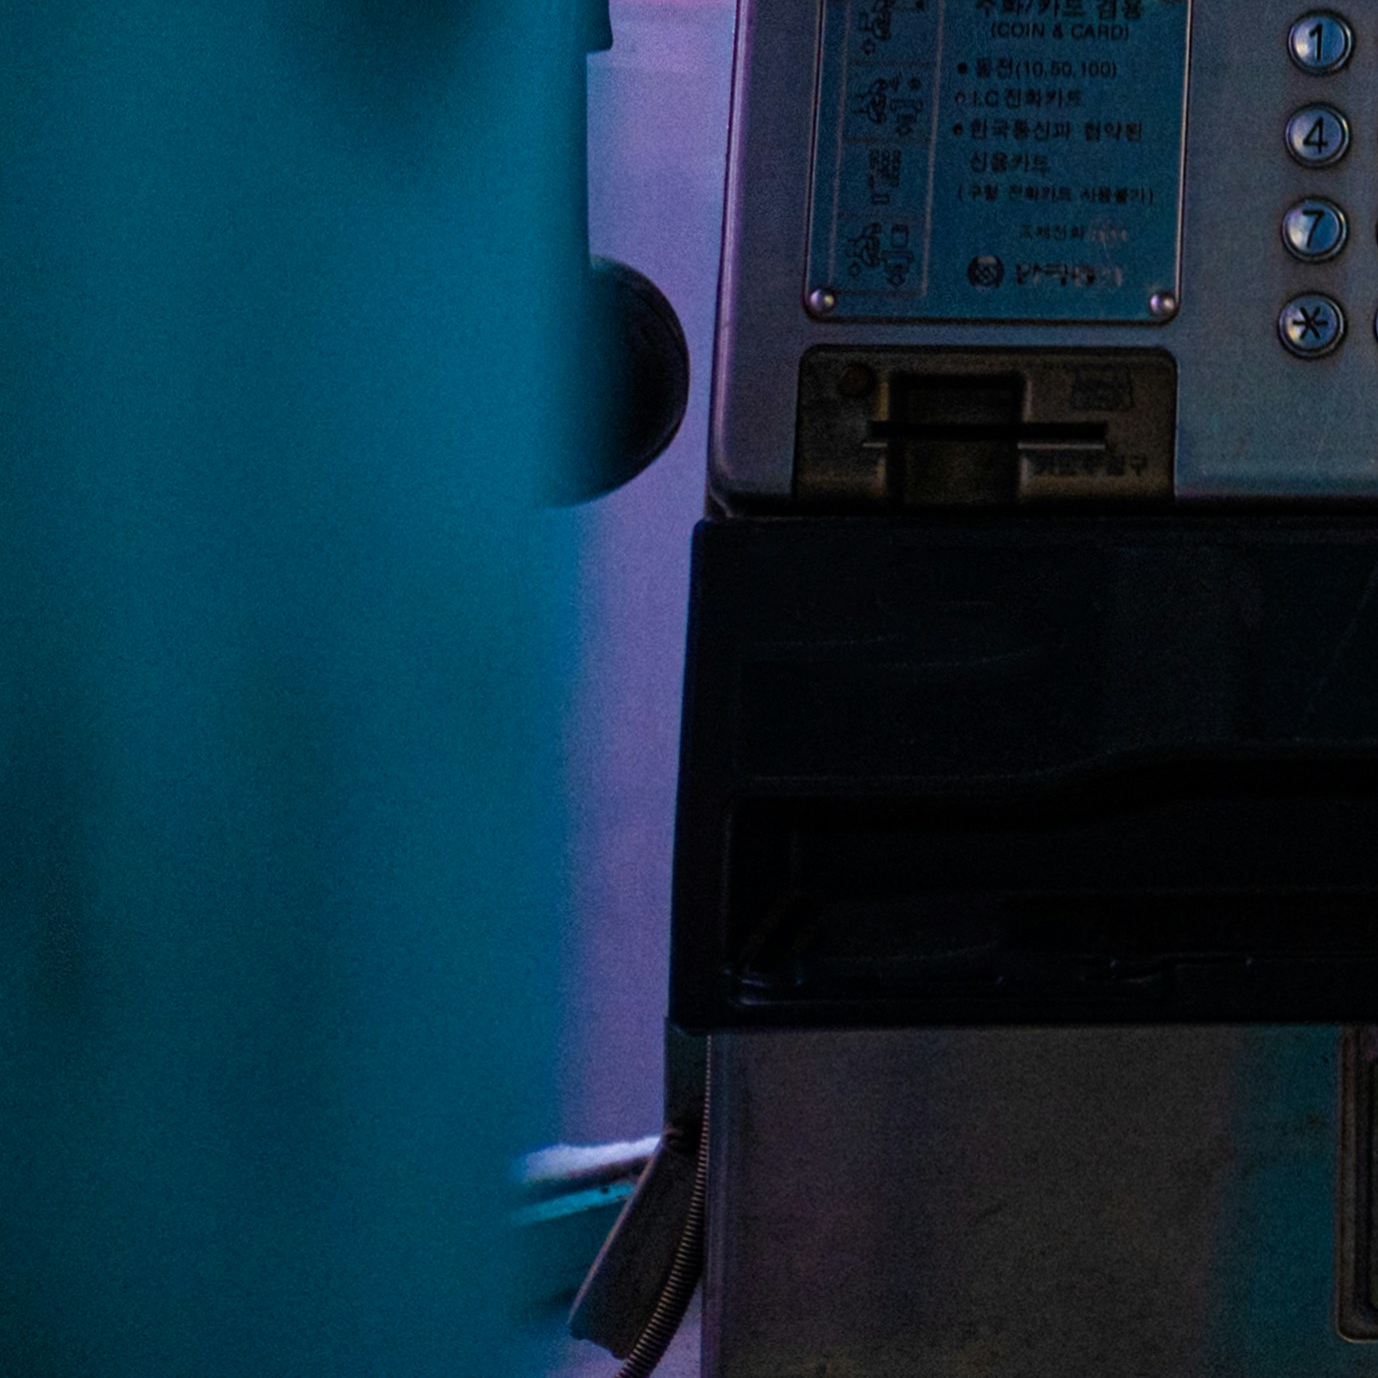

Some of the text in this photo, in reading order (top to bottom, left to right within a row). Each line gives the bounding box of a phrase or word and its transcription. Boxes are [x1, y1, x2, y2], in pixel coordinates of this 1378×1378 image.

[991, 22, 1130, 41] (COIN & CARD)
[1310, 24, 1322, 60] 1
[1303, 117, 1328, 154] 4
[1303, 210, 1325, 248] 7
